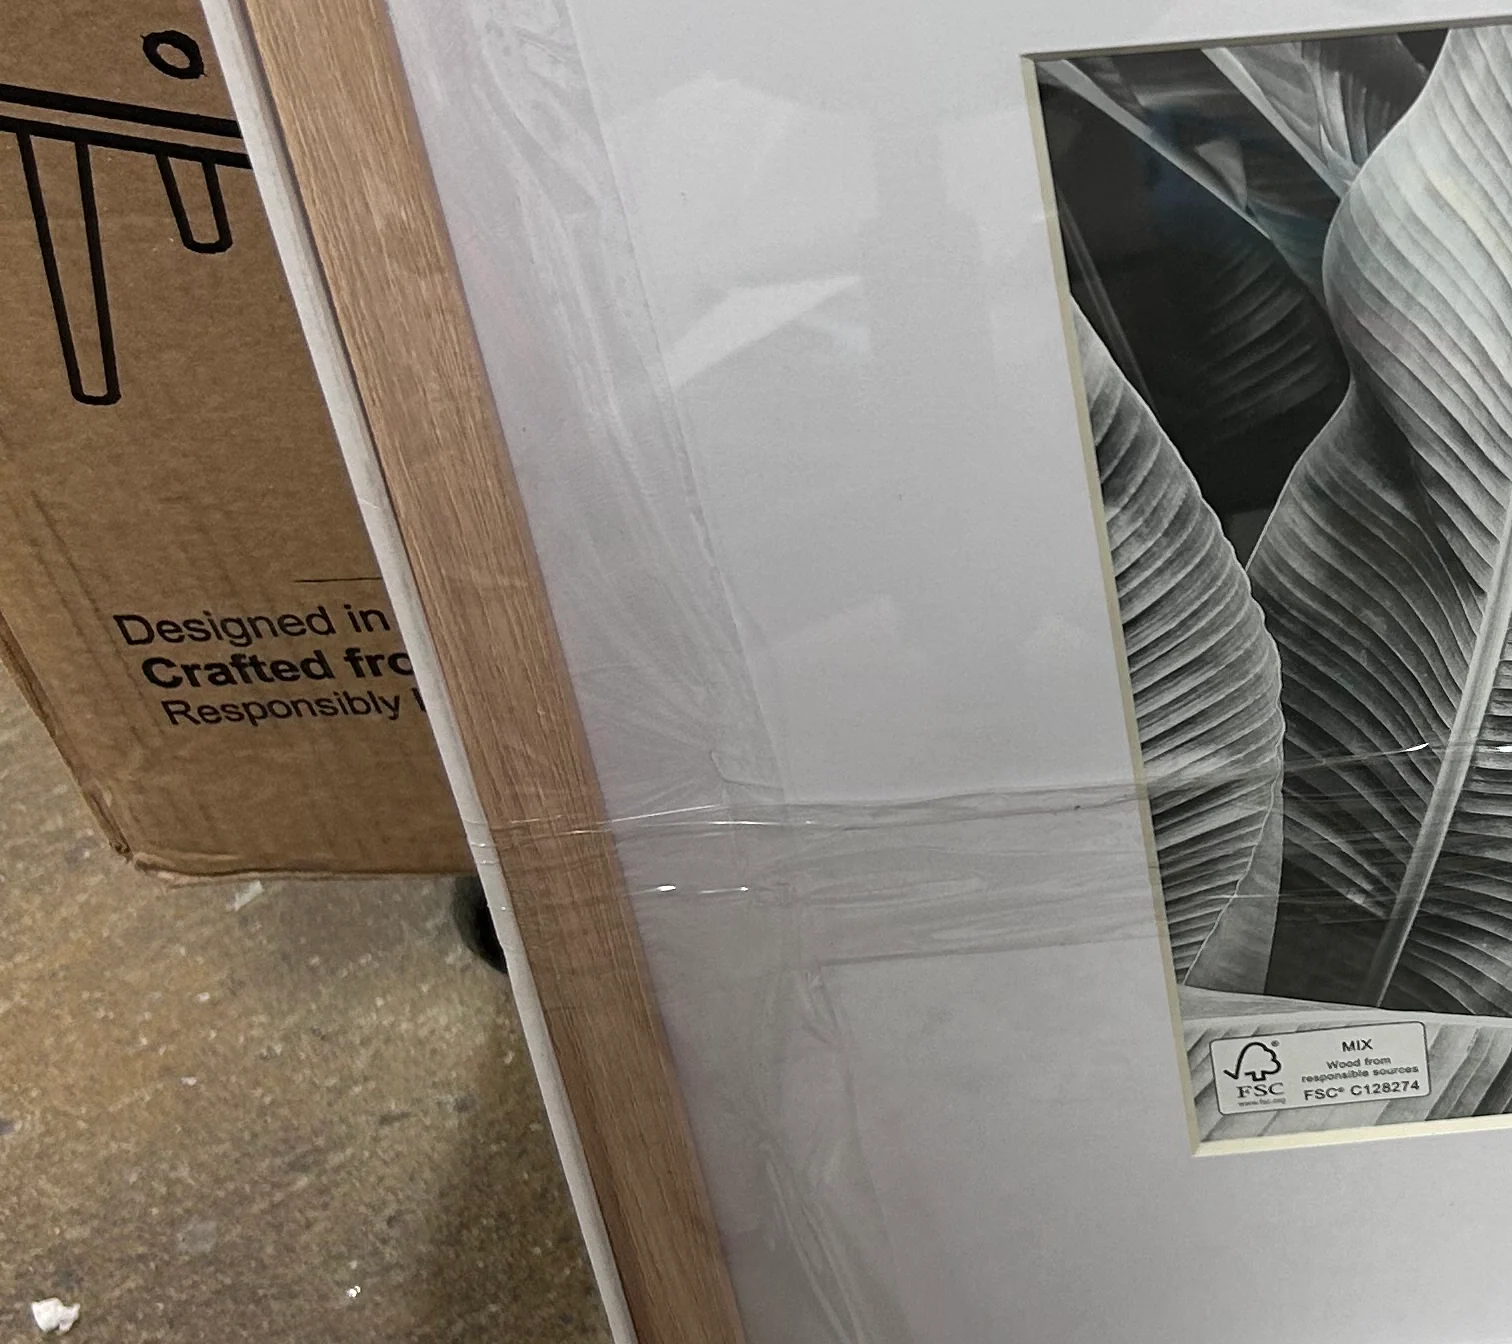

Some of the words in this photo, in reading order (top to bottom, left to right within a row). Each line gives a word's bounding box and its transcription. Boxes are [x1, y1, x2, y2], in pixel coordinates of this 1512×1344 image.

[112, 606, 337, 648] Designed
[343, 603, 391, 633] in
[140, 649, 336, 690] Crafted
[160, 690, 400, 727] Responsibly
[1341, 1038, 1374, 1052] MIX
[1325, 1058, 1361, 1069] Wood
[1364, 1056, 1392, 1066] from
[1301, 1069, 1370, 1084] responsible
[1372, 1065, 1420, 1077] sources
[1236, 1081, 1285, 1098] FSC
[1350, 1079, 1420, 1096] C128274
